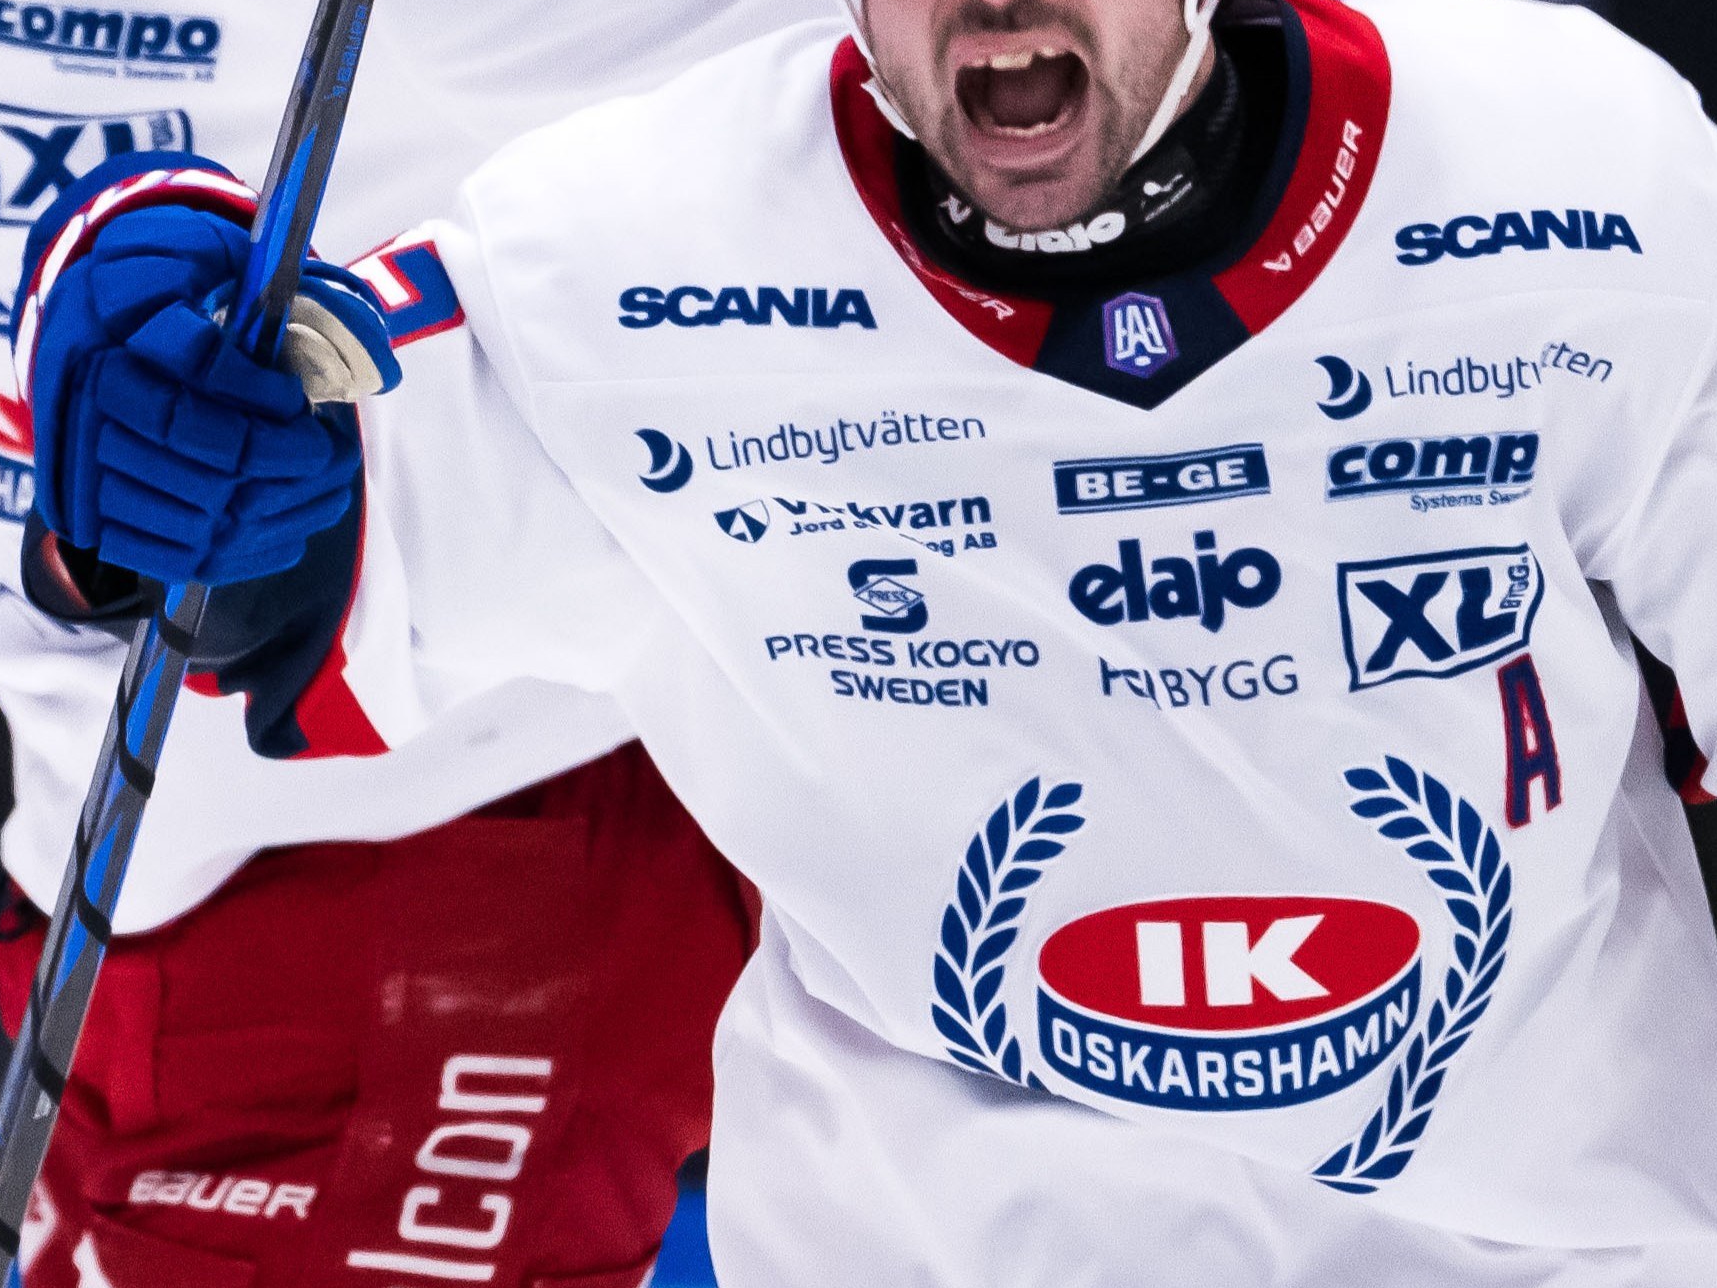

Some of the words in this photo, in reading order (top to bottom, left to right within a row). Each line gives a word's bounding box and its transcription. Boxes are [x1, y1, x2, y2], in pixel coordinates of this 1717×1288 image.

[1293, 119, 1363, 257] BAUER
[1395, 208, 1643, 266] SCANIA
[618, 286, 878, 330] SCANIA
[706, 409, 987, 471] Lindbytvätten
[1328, 432, 1540, 486] comp
[788, 517, 847, 536] Jord
[964, 531, 998, 551] AB
[1068, 529, 1282, 634] elajo
[1354, 566, 1519, 675] XL
[764, 634, 897, 668] PRESS
[907, 638, 1042, 668] KOGYO
[829, 668, 991, 708] SWEDEN
[1497, 651, 1562, 830] A
[1135, 913, 1331, 1008] IK
[1052, 986, 1414, 1100] OSKARSHAMN
[128, 1169, 316, 1219] BAUER
